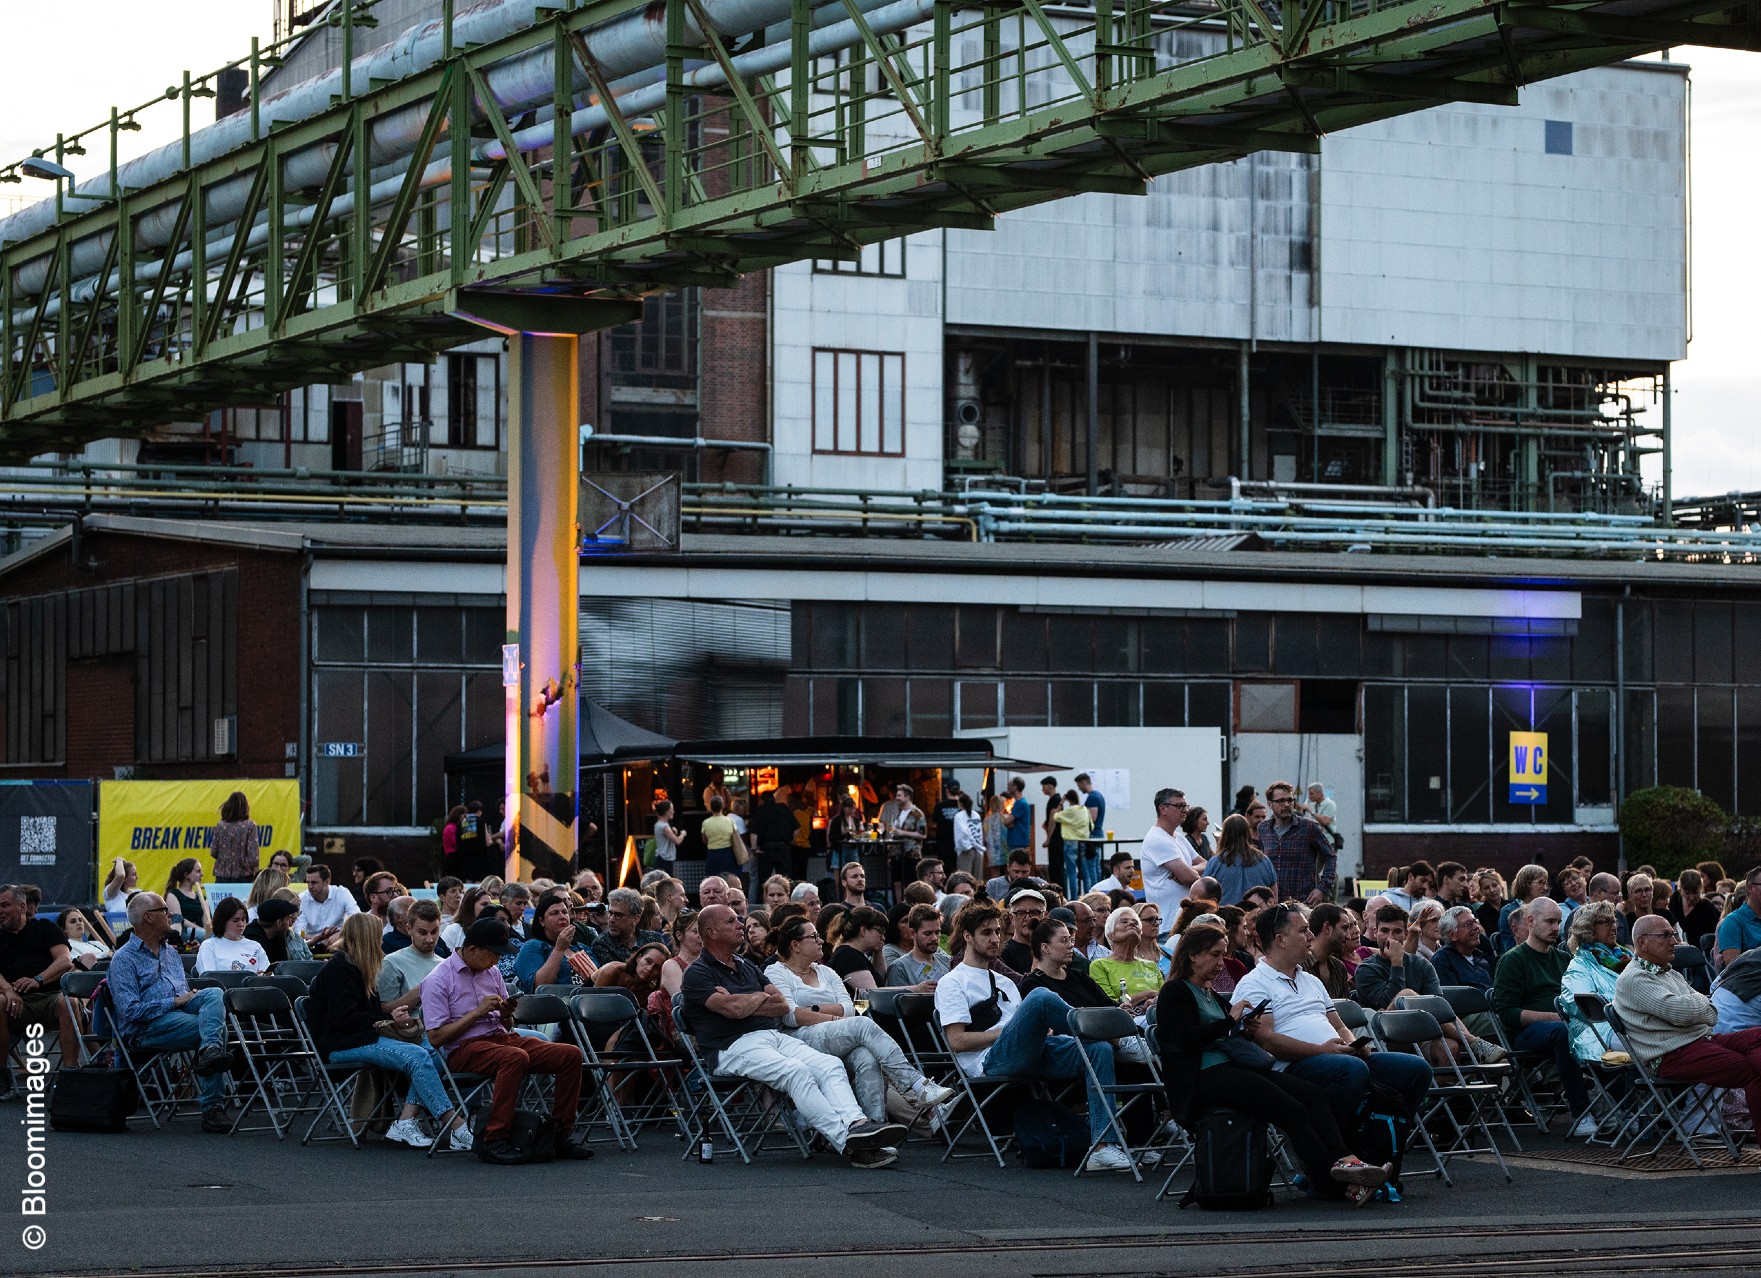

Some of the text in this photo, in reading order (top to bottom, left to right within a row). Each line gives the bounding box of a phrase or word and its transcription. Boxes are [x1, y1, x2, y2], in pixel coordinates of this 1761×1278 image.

[328, 743, 354, 756] SN 3
[1514, 745, 1543, 775] WC
[131, 826, 217, 850] BREAK NEW
